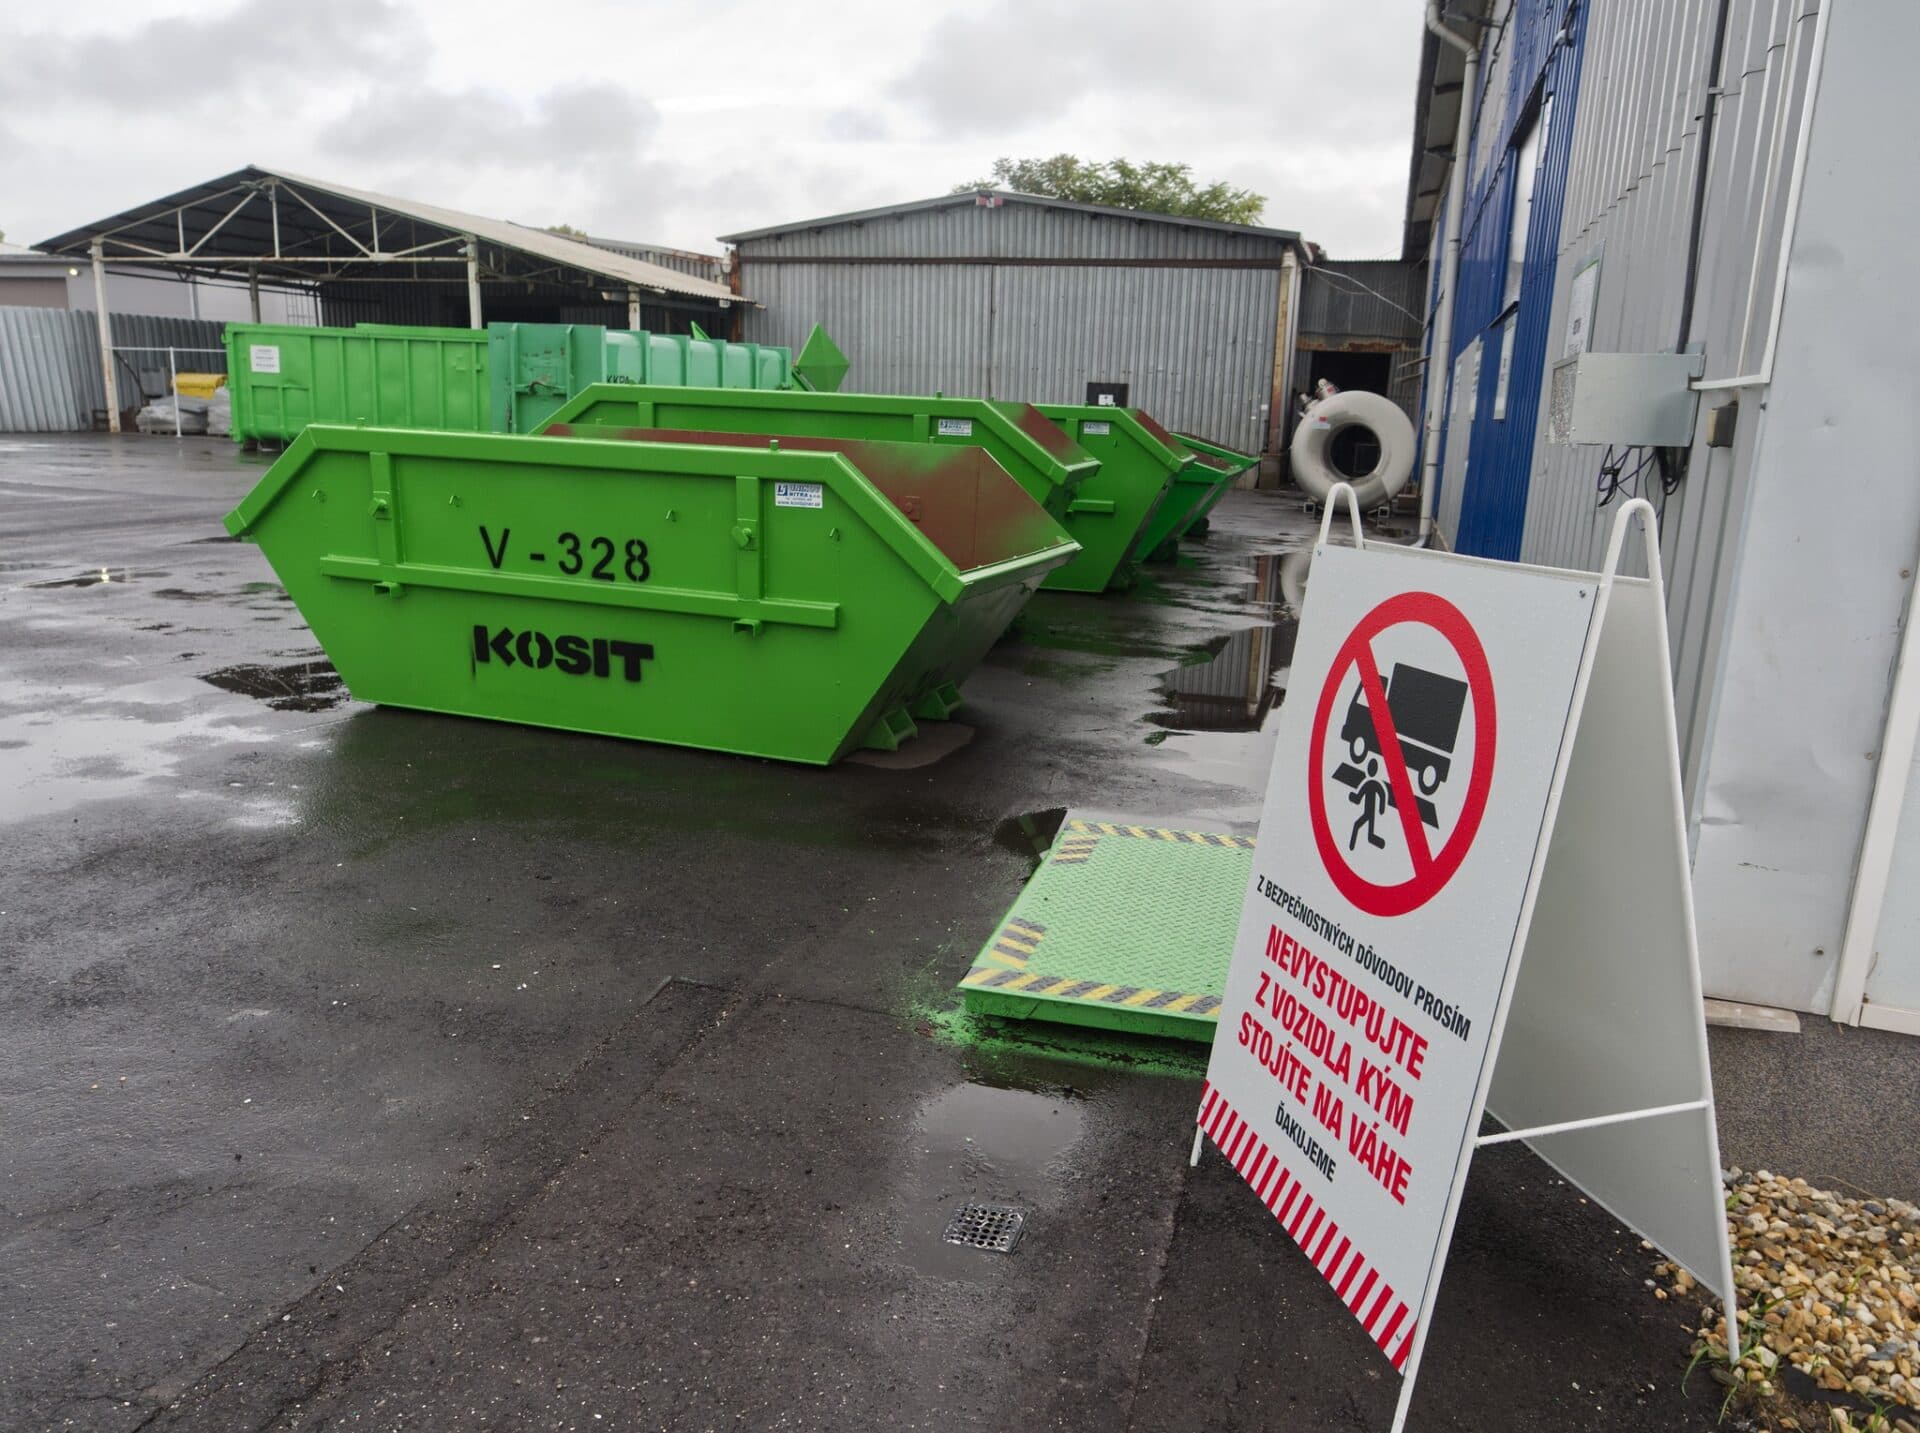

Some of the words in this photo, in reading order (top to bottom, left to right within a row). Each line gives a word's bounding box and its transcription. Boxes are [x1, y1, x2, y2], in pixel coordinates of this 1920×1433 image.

[473, 624, 654, 683] KOSIT
[1256, 875, 1265, 893] Z
[1264, 880, 1355, 957] BEZPEČNOSTNÝCH
[1355, 943, 1415, 999] DÔVODOV
[1414, 985, 1472, 1042] PROSÍM
[1265, 924, 1428, 1081] NEVYSTUPUJTE
[1238, 1011, 1312, 1106] STOJÍTE
[1312, 1081, 1344, 1141] NA
[1348, 1112, 1413, 1206] VÁHE
[1255, 971, 1271, 1008] Z
[1271, 982, 1352, 1085] VOZIDLA
[1355, 1056, 1414, 1137] KÝM
[1275, 1100, 1337, 1183] ĎAKUJEME
